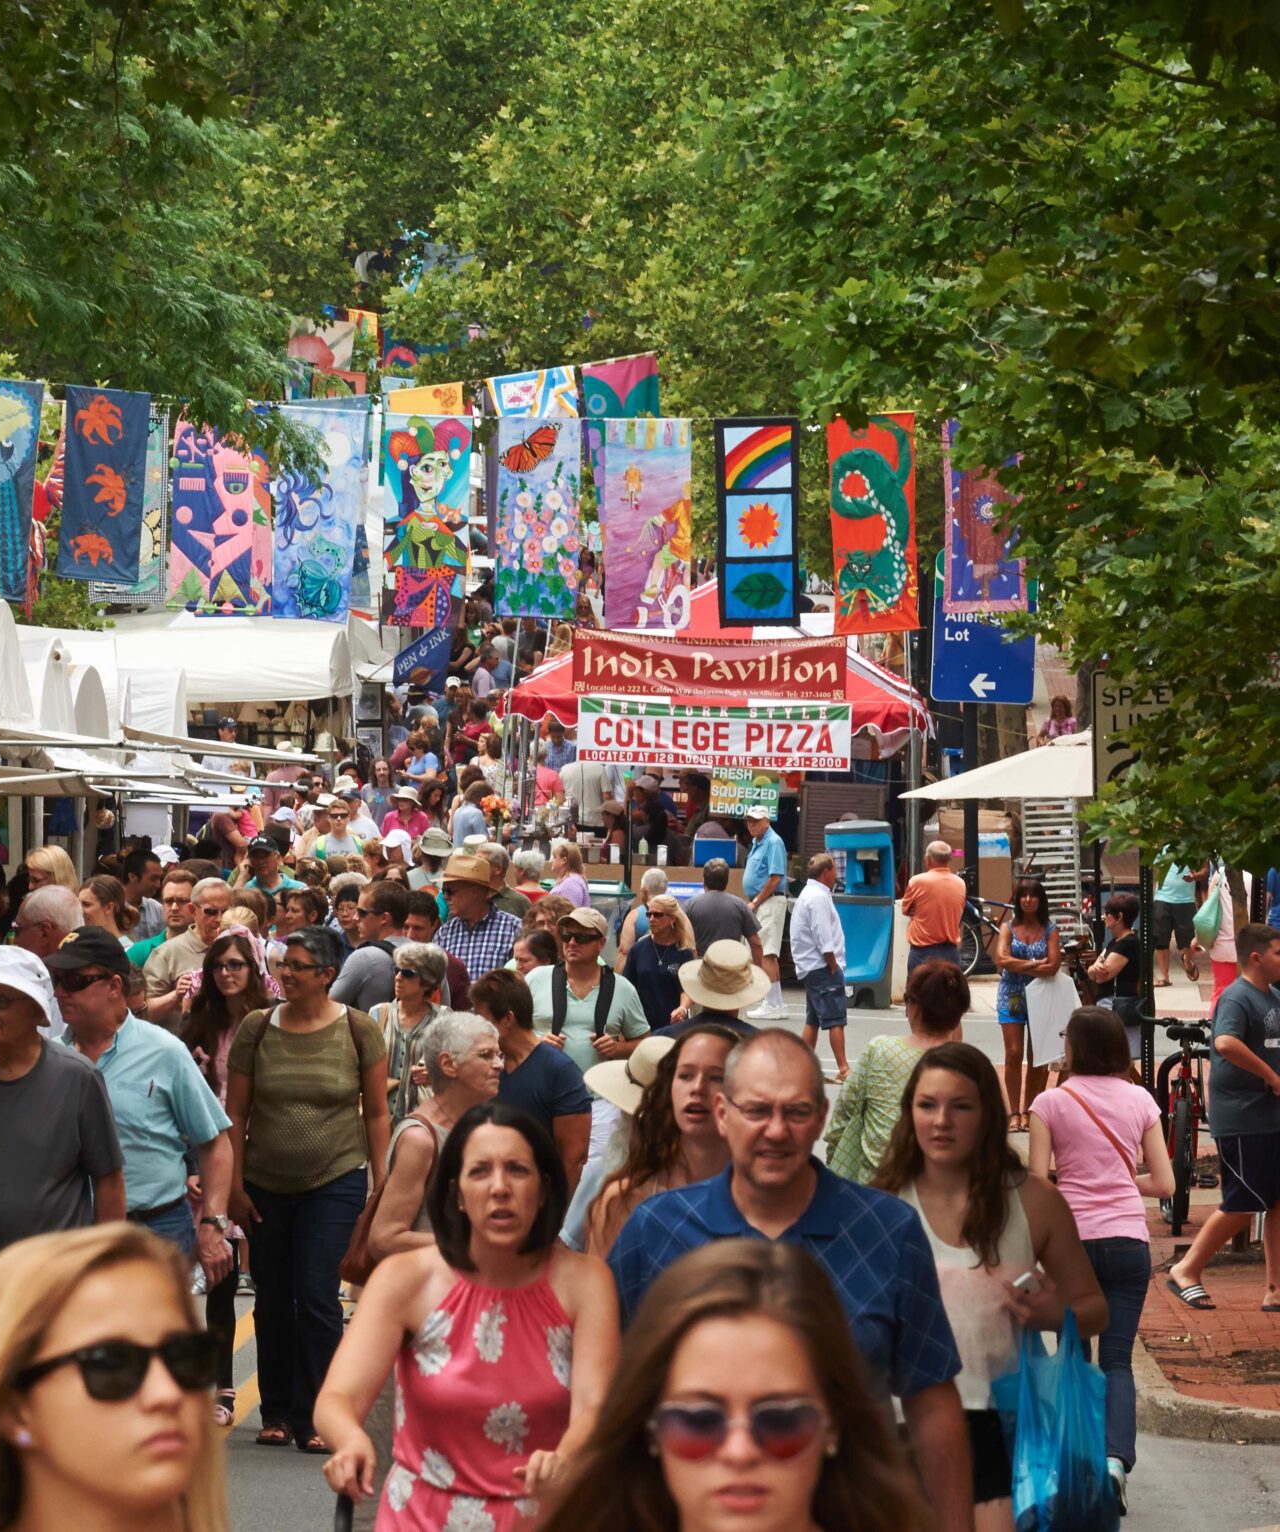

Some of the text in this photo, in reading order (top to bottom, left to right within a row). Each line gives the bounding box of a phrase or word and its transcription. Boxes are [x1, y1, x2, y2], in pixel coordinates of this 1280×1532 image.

[642, 635, 681, 645] EXOTIC
[686, 637, 729, 647] INDIAN
[945, 628, 969, 641] Lot
[396, 627, 451, 676] PEN & INK
[582, 646, 838, 683] India Pavilion
[586, 684, 617, 692] Located
[627, 685, 640, 693] 222
[650, 685, 673, 694] Calder
[786, 691, 798, 699] Tel:
[800, 691, 831, 699] 237-3400
[603, 700, 828, 720] NEW YORK STYLE
[594, 717, 833, 753] COLLEGE PIZZA
[585, 750, 842, 768] LOCATED AT 128 LOCUST LANE TEL: 231-2000
[712, 767, 753, 780] FRESH
[711, 785, 777, 800] SQUEEZED
[709, 801, 776, 817] LEMONE
